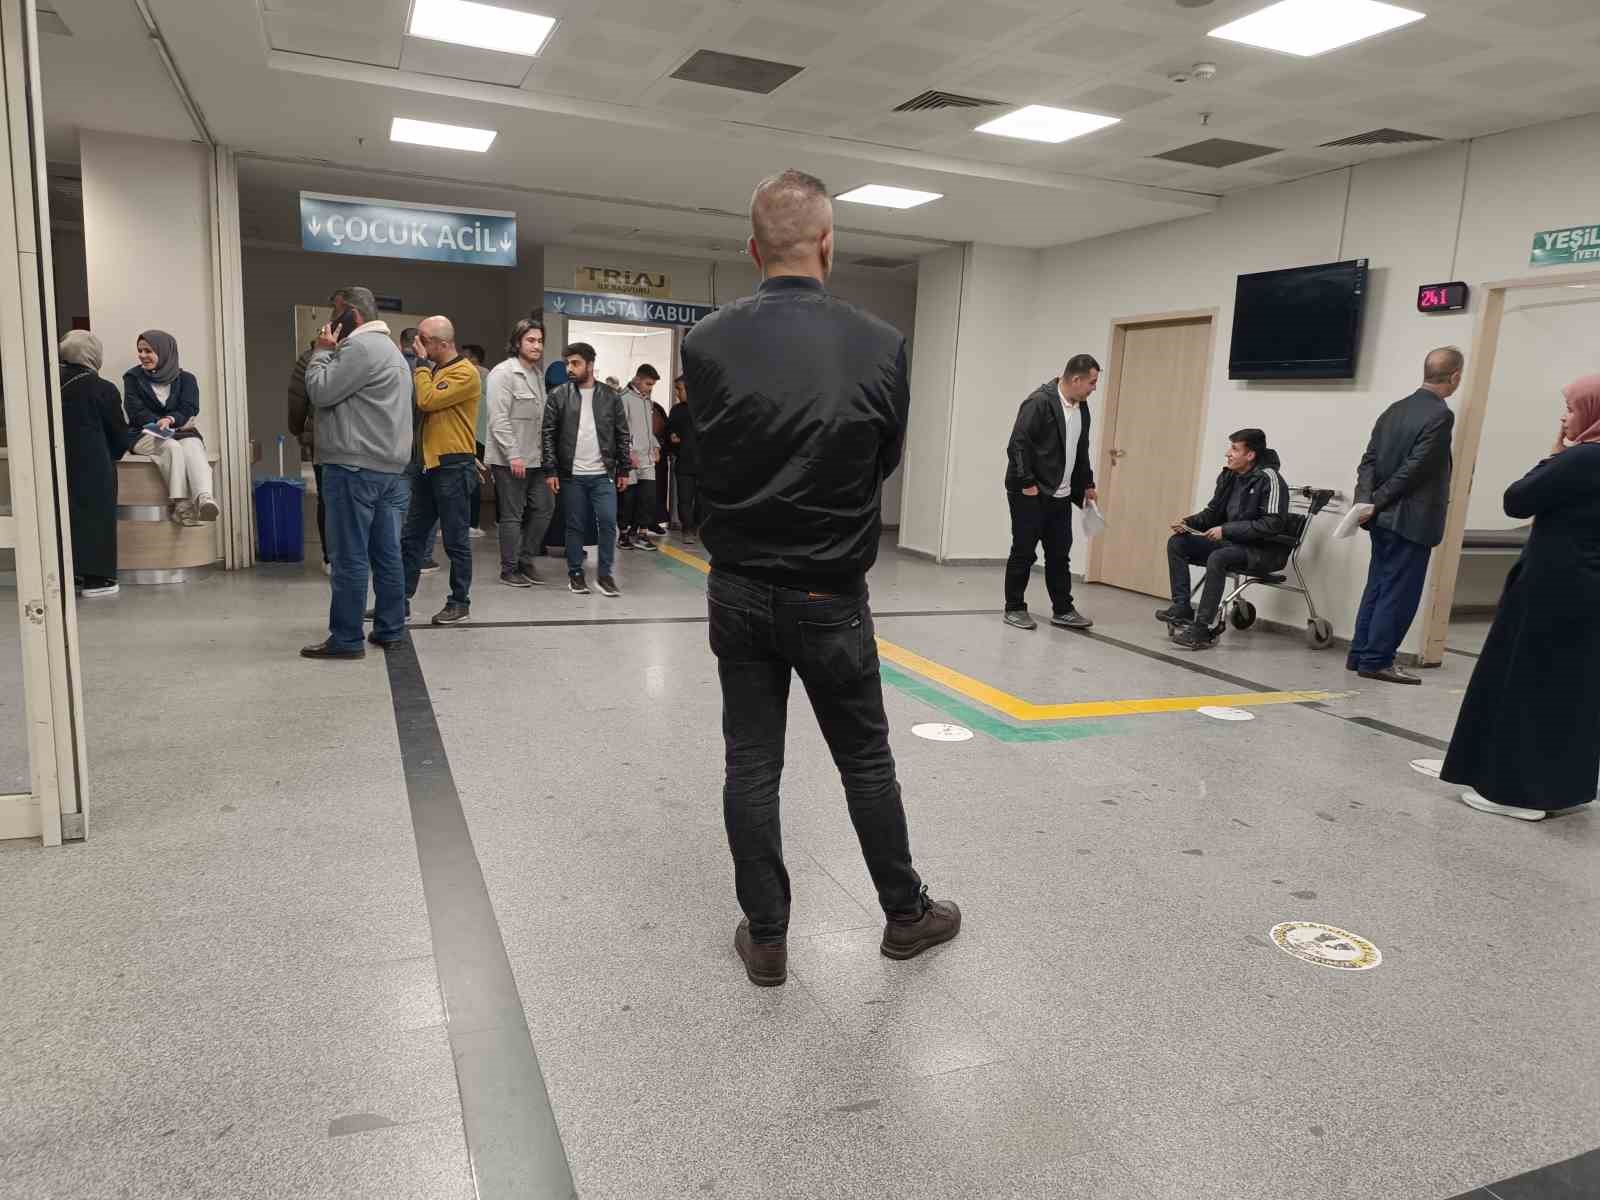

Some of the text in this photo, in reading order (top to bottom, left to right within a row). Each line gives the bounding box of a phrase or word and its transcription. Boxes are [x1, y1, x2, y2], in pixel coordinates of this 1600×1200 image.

[327, 214, 497, 252] ÇOCUK ACİL
[1543, 228, 1600, 251] YEŞİL
[581, 297, 700, 323] HASTA KABUL
